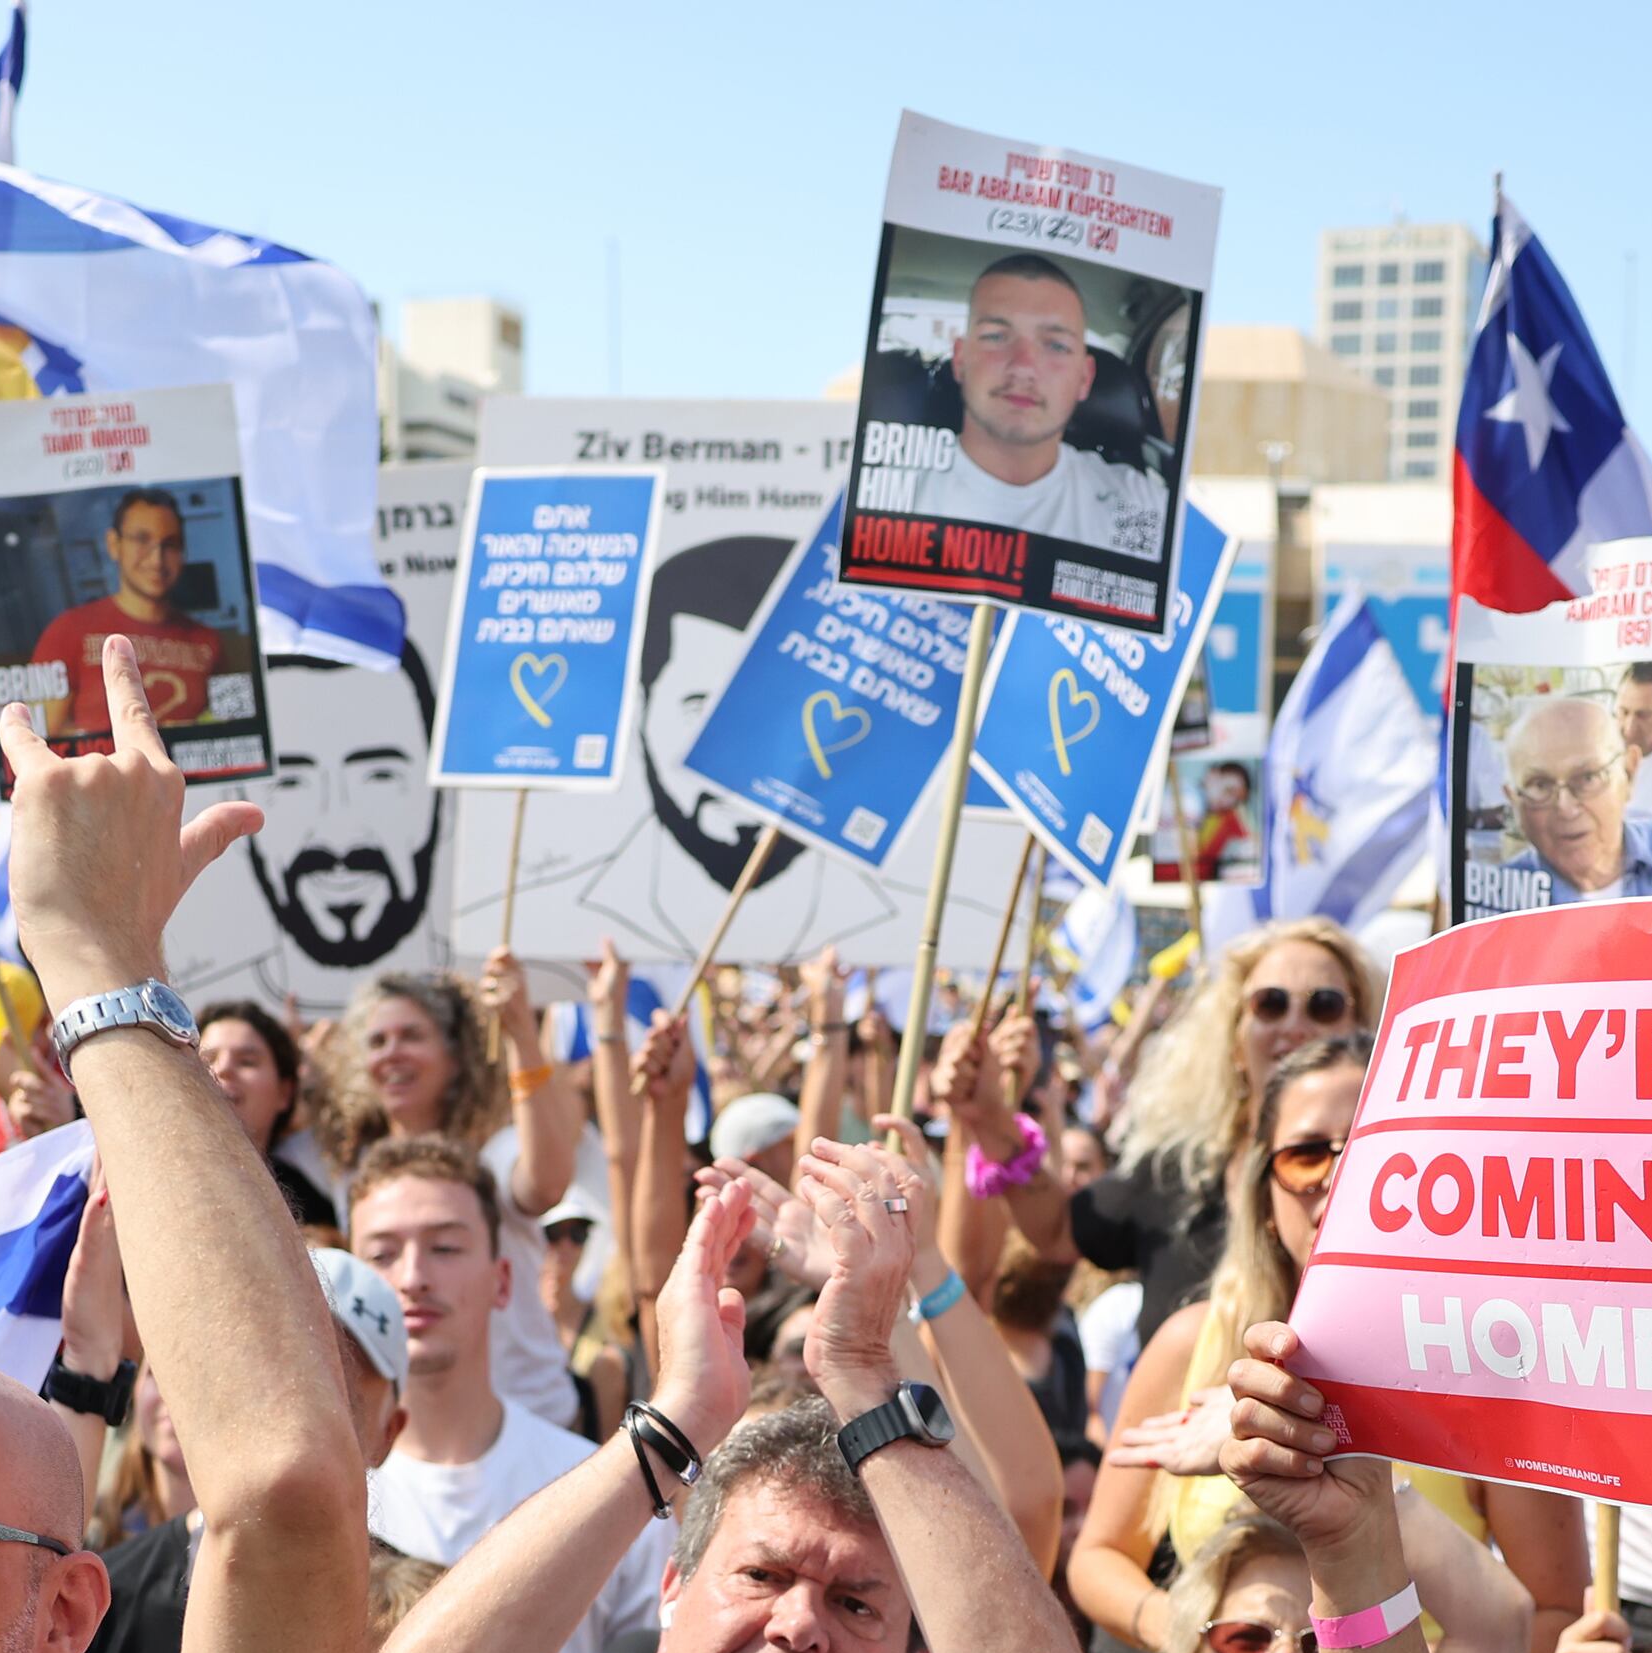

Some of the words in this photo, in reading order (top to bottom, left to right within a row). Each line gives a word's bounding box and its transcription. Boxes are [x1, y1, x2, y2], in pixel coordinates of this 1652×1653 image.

[938, 165, 972, 193] BAR
[976, 172, 1062, 209] ABRAHAM
[1067, 191, 1175, 238] KUPERSHTEIN
[577, 432, 631, 462] Ziv
[643, 434, 781, 463] Berman
[862, 421, 955, 472] BRING
[855, 465, 918, 513] HIM
[533, 505, 592, 529] אתם
[851, 515, 937, 567] HOME
[940, 525, 1029, 582] NOW!
[552, 561, 627, 586] שלהם
[1566, 592, 1637, 622] AMIRAM
[1465, 862, 1552, 910] BRING
[1514, 1458, 1622, 1487] WOMENDEMANDLIFE
